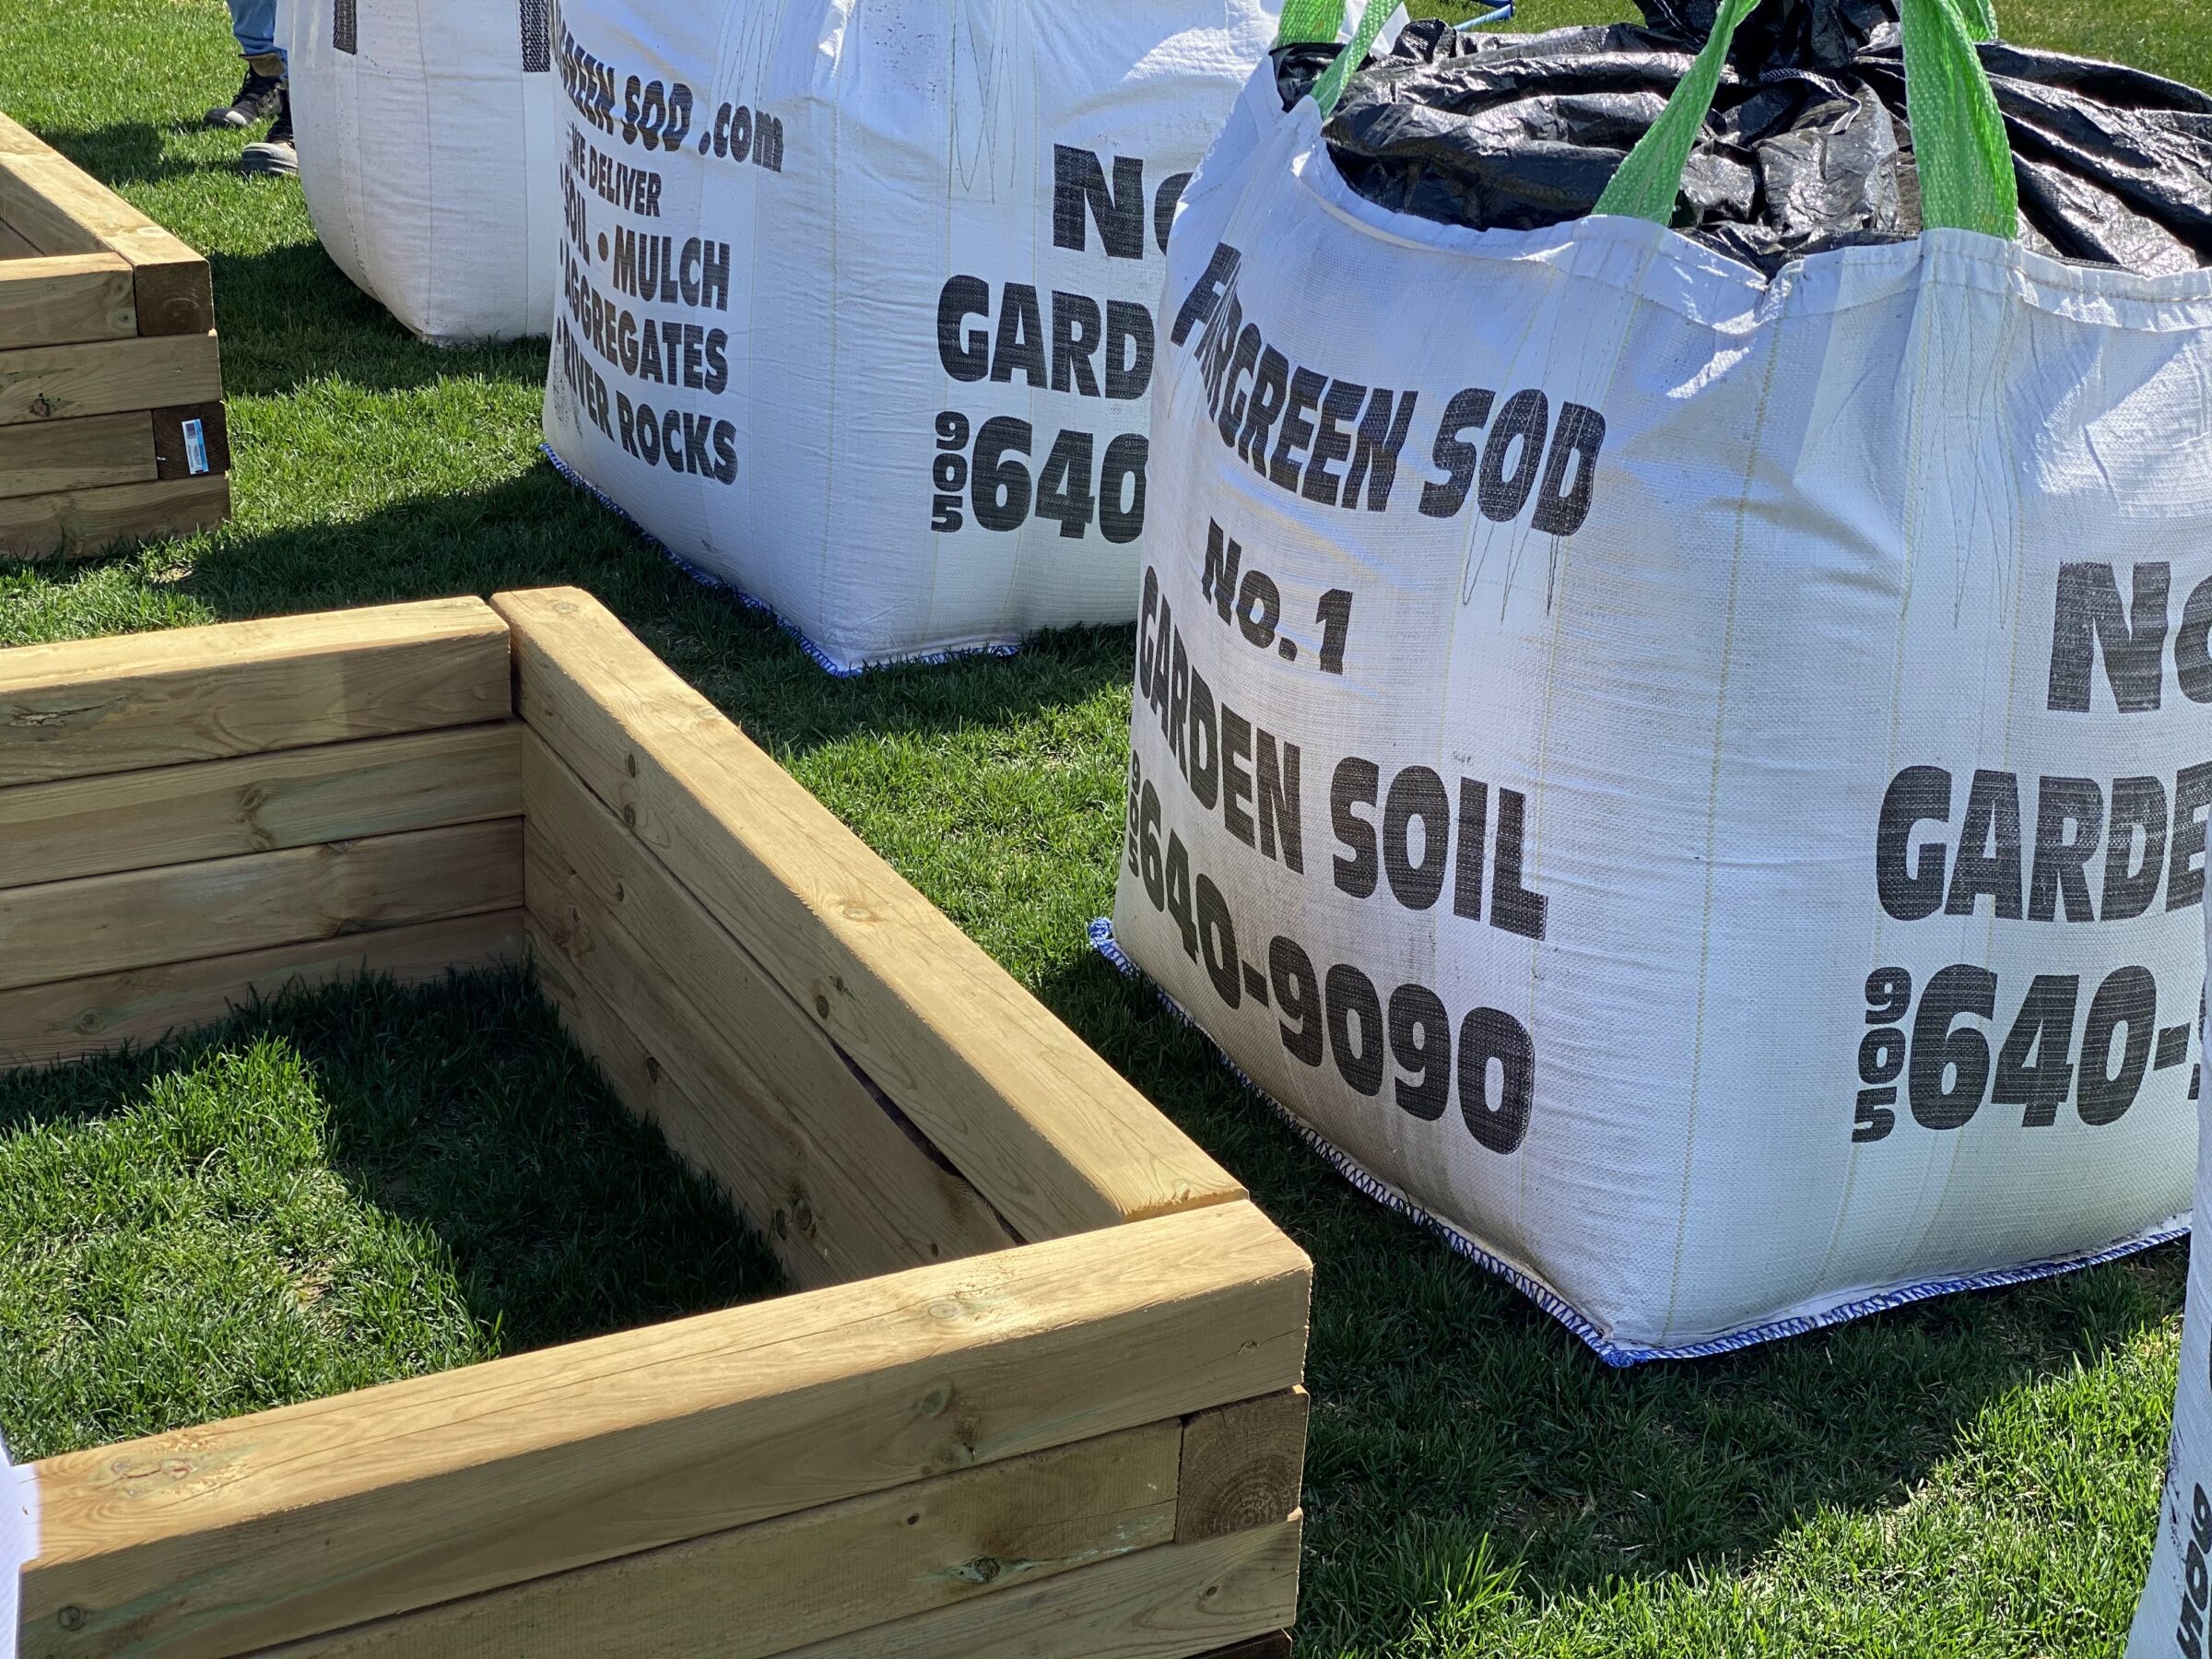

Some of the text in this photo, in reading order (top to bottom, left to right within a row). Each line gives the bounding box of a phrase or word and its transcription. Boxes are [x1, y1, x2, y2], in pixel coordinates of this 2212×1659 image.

[571, 122, 662, 218] WE DELIVER
[622, 75, 694, 151] SOD
[564, 163, 731, 311] SOIL MULCH
[565, 242, 730, 395] AGGREGATES
[936, 275, 1155, 400] GARD
[563, 312, 737, 486] RIVER ROCKS
[931, 411, 970, 533] 905
[1418, 387, 1606, 537] SOD
[1139, 565, 1549, 942] GARDEN SOIL
[1128, 749, 1535, 1156] 905 640-9090
[1852, 963, 2206, 1145] 905 640-
